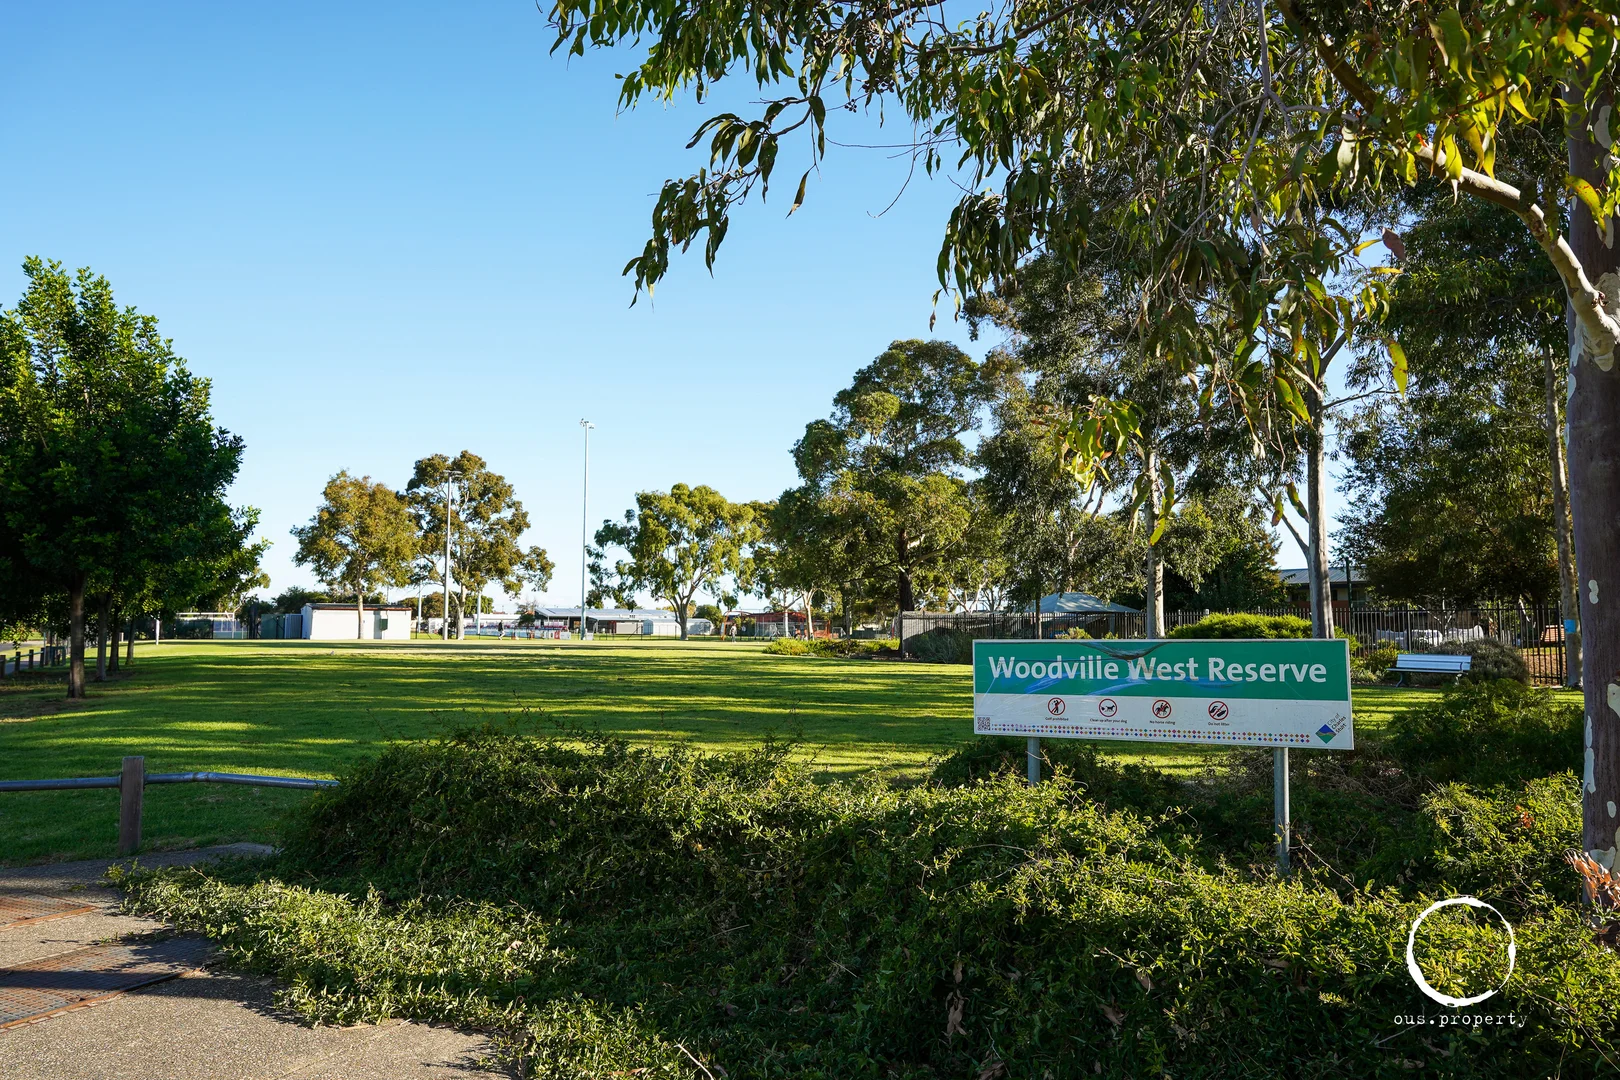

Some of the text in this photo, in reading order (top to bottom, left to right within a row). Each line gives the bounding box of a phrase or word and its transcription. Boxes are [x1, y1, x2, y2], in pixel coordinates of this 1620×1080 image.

[988, 655, 1327, 683] Woodville West Reserve
